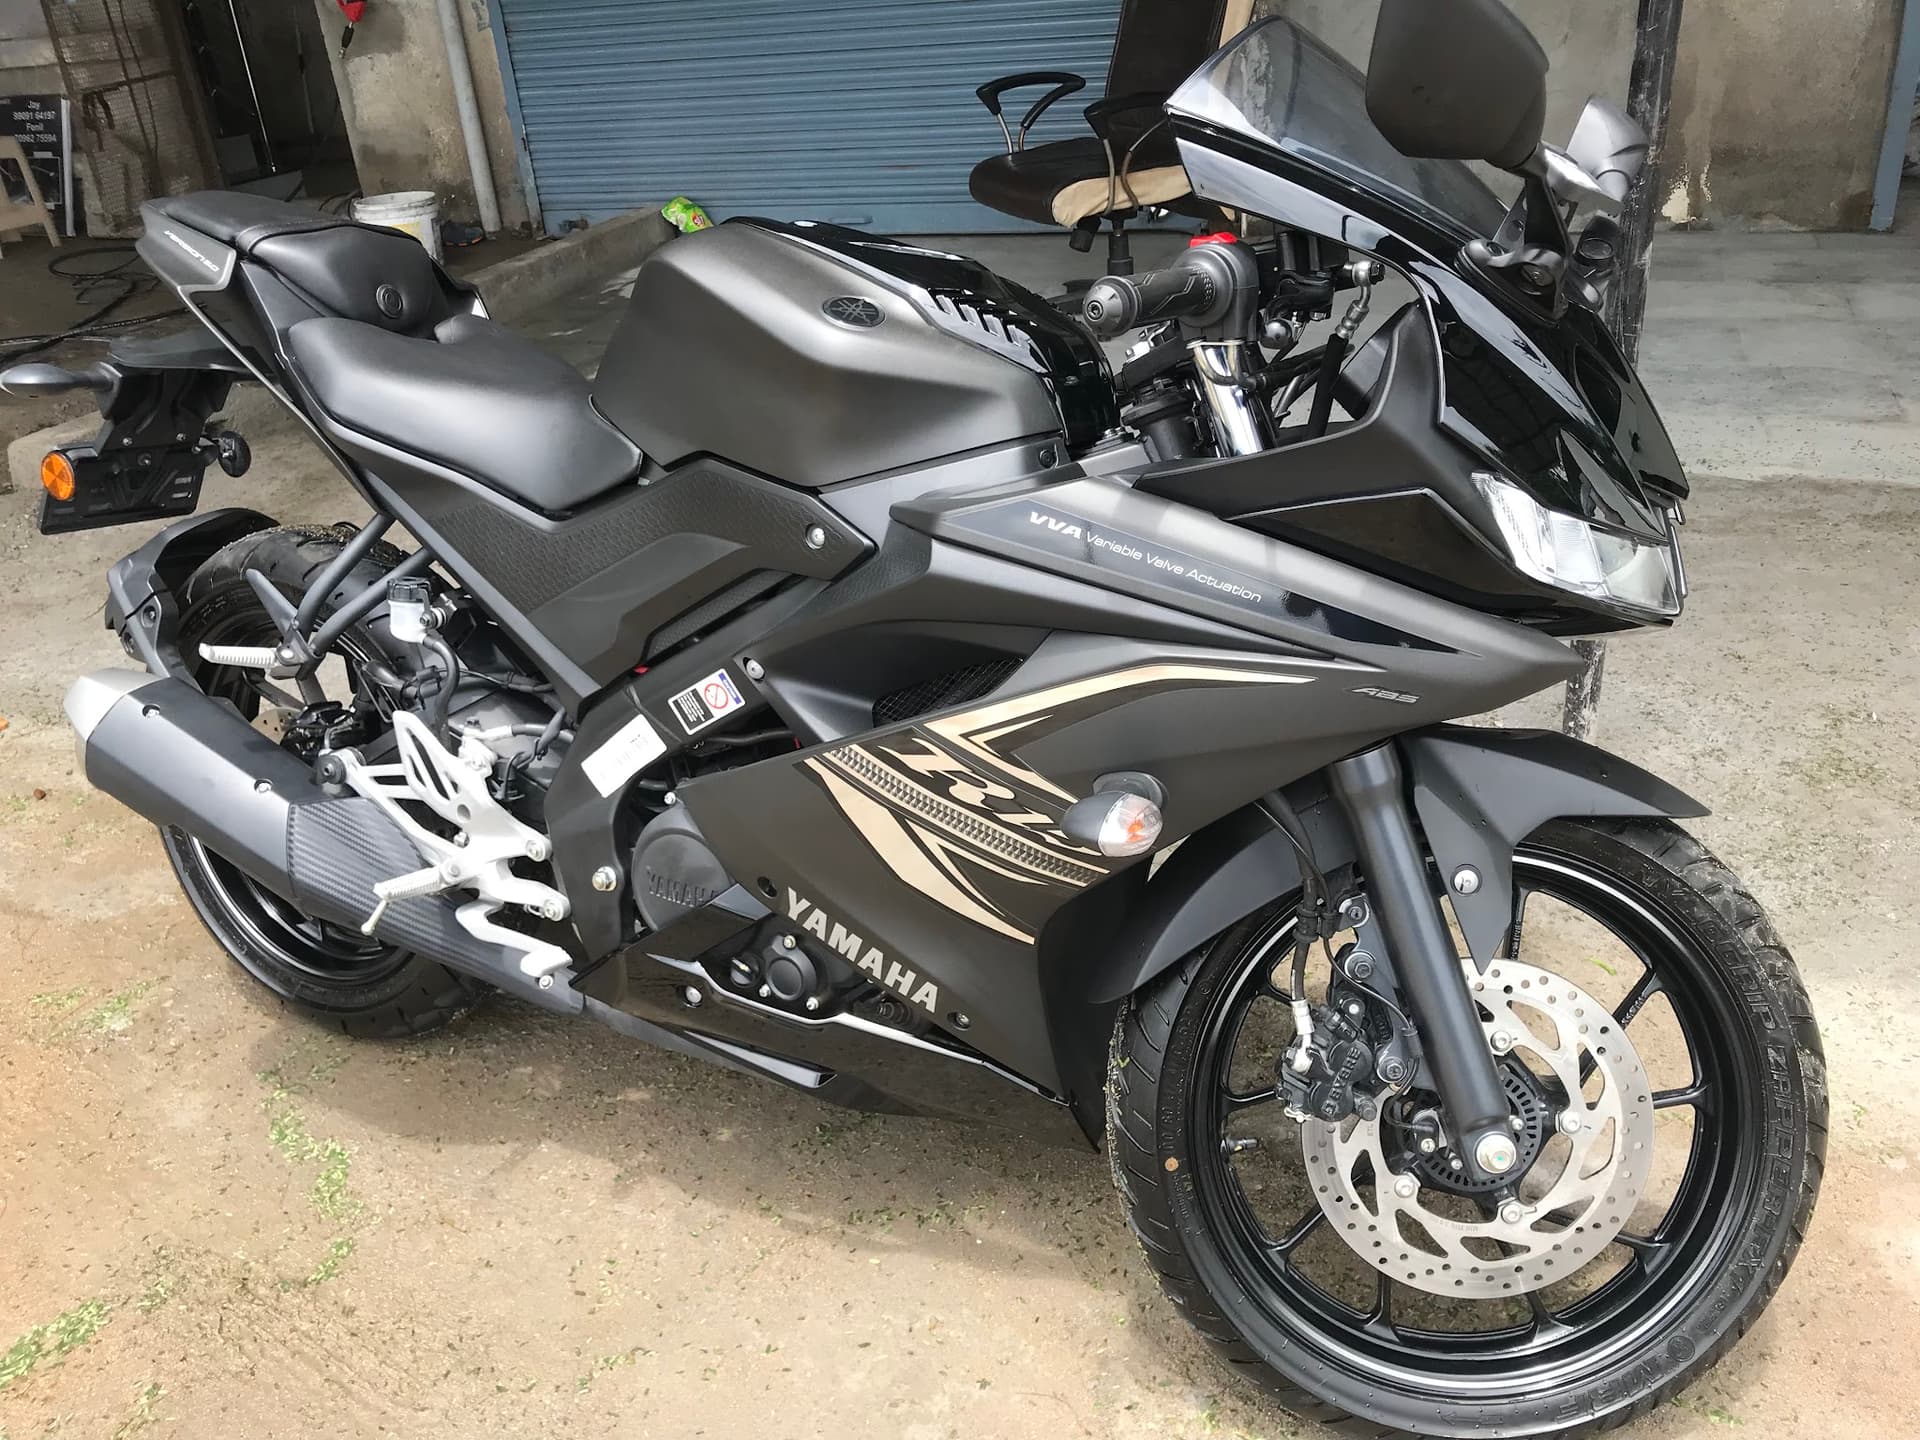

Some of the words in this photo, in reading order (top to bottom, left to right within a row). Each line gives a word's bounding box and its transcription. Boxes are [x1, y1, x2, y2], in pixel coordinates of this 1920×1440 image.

[1030, 511, 1082, 540] VVA
[1086, 531, 1143, 561] Variable
[1146, 552, 1184, 576] Valve
[1186, 568, 1263, 604] Actuation
[1351, 687, 1420, 704] ABS
[786, 886, 939, 1014] YAMAHA
